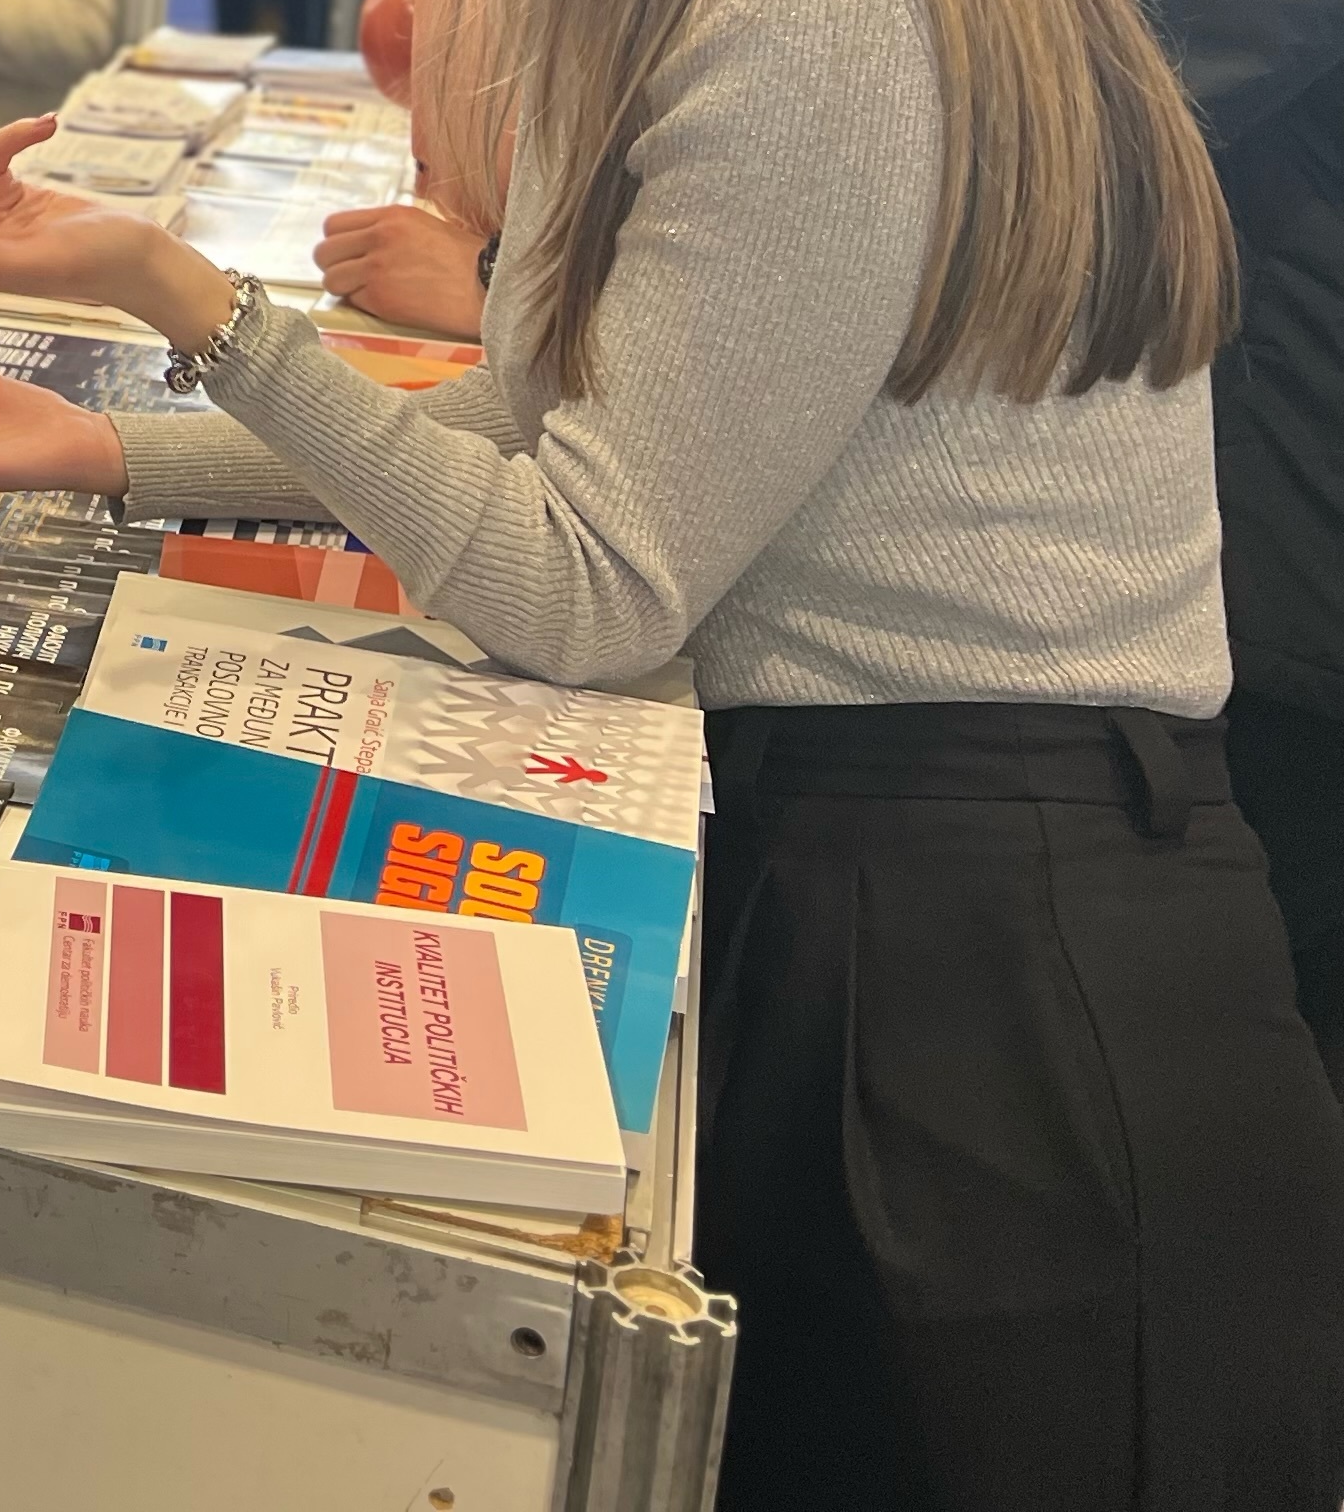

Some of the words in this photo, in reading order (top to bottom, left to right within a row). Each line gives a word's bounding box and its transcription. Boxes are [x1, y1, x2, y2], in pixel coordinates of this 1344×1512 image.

[164, 645, 209, 720] TRANSAKCIJE
[257, 658, 290, 681] ZA
[196, 650, 247, 739] POSLOVNO
[367, 678, 395, 707] Sanja
[286, 667, 353, 768] PRAKT
[57, 910, 68, 930] FPN
[62, 935, 75, 960] Centar
[81, 938, 95, 969] Fakultet
[61, 960, 71, 970] za
[412, 929, 450, 1010] KVALITET
[79, 1008, 93, 1032] nauka
[375, 960, 412, 1065] INSTITUCIJA
[423, 1010, 468, 1116] POLITIČKIH
